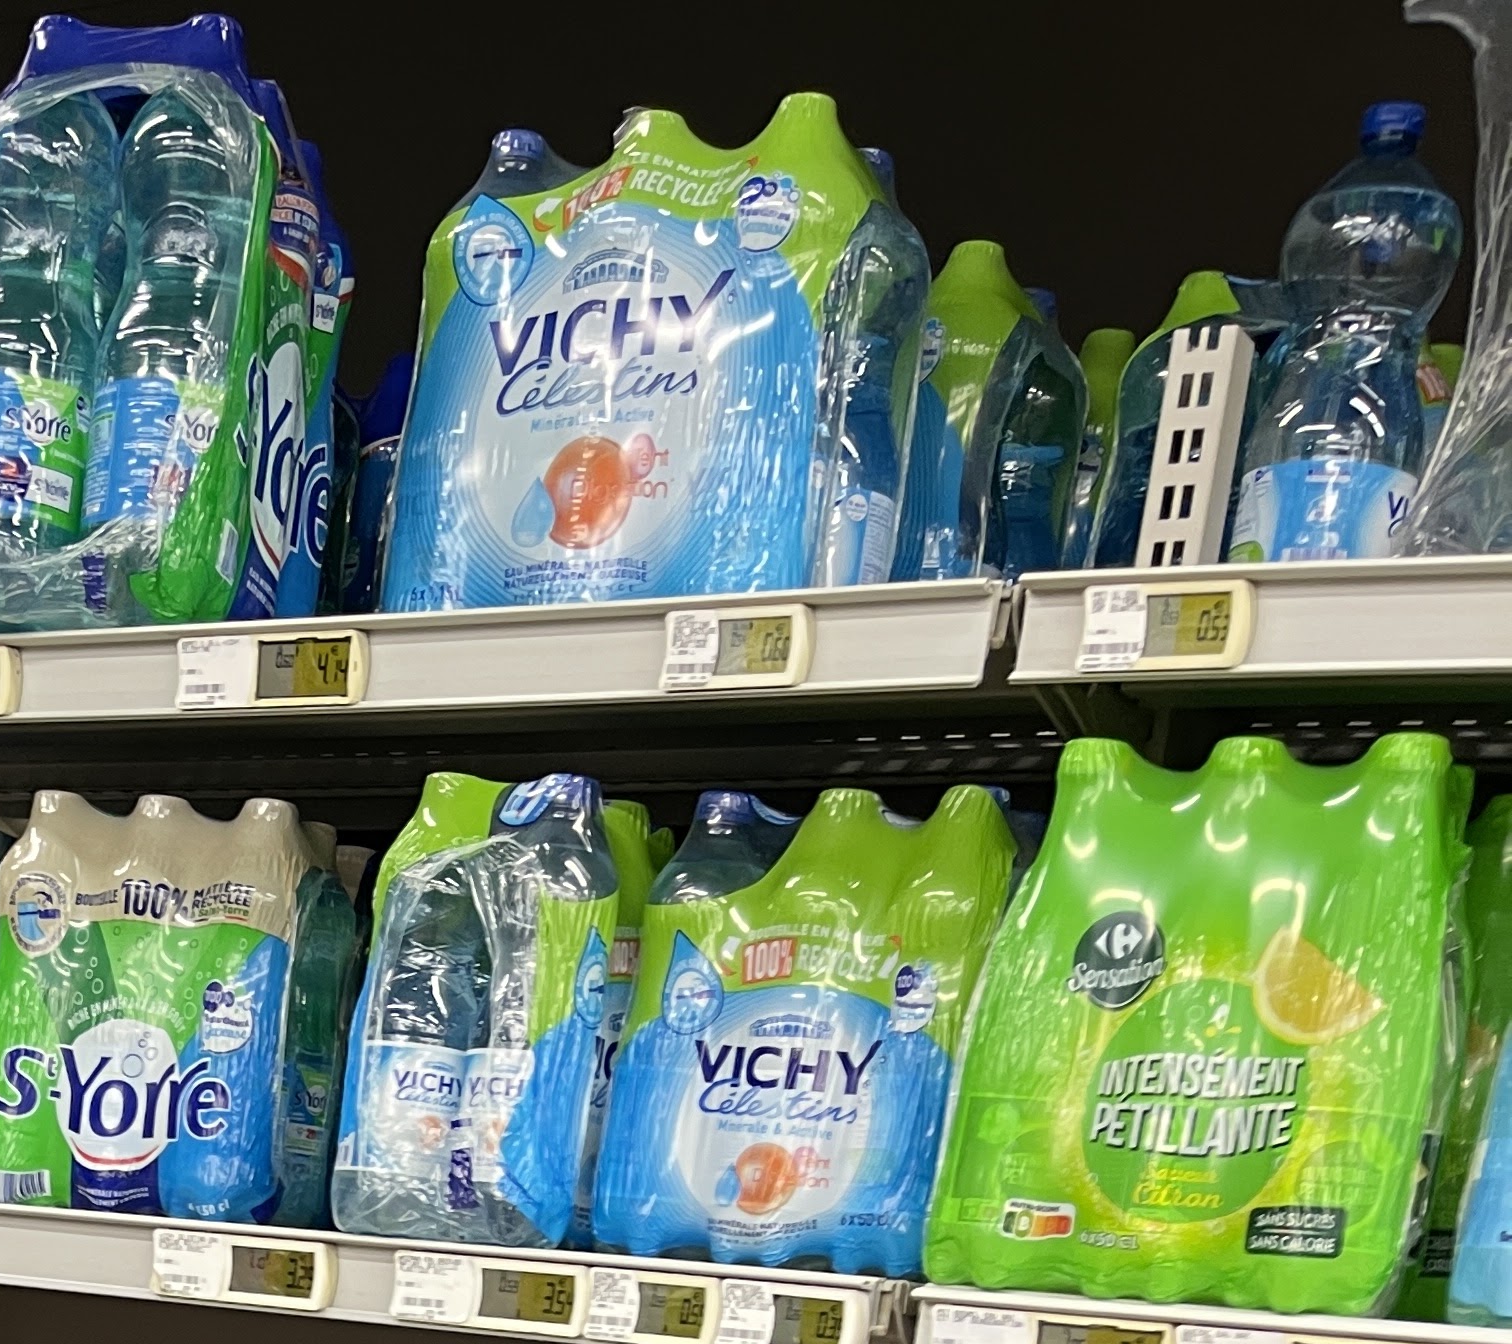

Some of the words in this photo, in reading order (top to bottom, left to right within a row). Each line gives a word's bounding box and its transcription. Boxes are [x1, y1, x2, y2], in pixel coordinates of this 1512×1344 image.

[489, 268, 736, 377] VICHY
[496, 356, 700, 417] Célestins
[120, 877, 189, 921] 100%
[742, 940, 795, 981] 100%
[1067, 958, 1165, 994] Sensation
[468, 1074, 524, 1099] VICH
[694, 1039, 883, 1096] VICHY
[1096, 1047, 1306, 1101] INTENSÉMENT
[697, 1079, 859, 1126] Célestins
[1088, 1090, 1300, 1160] PÉTILLANTE
